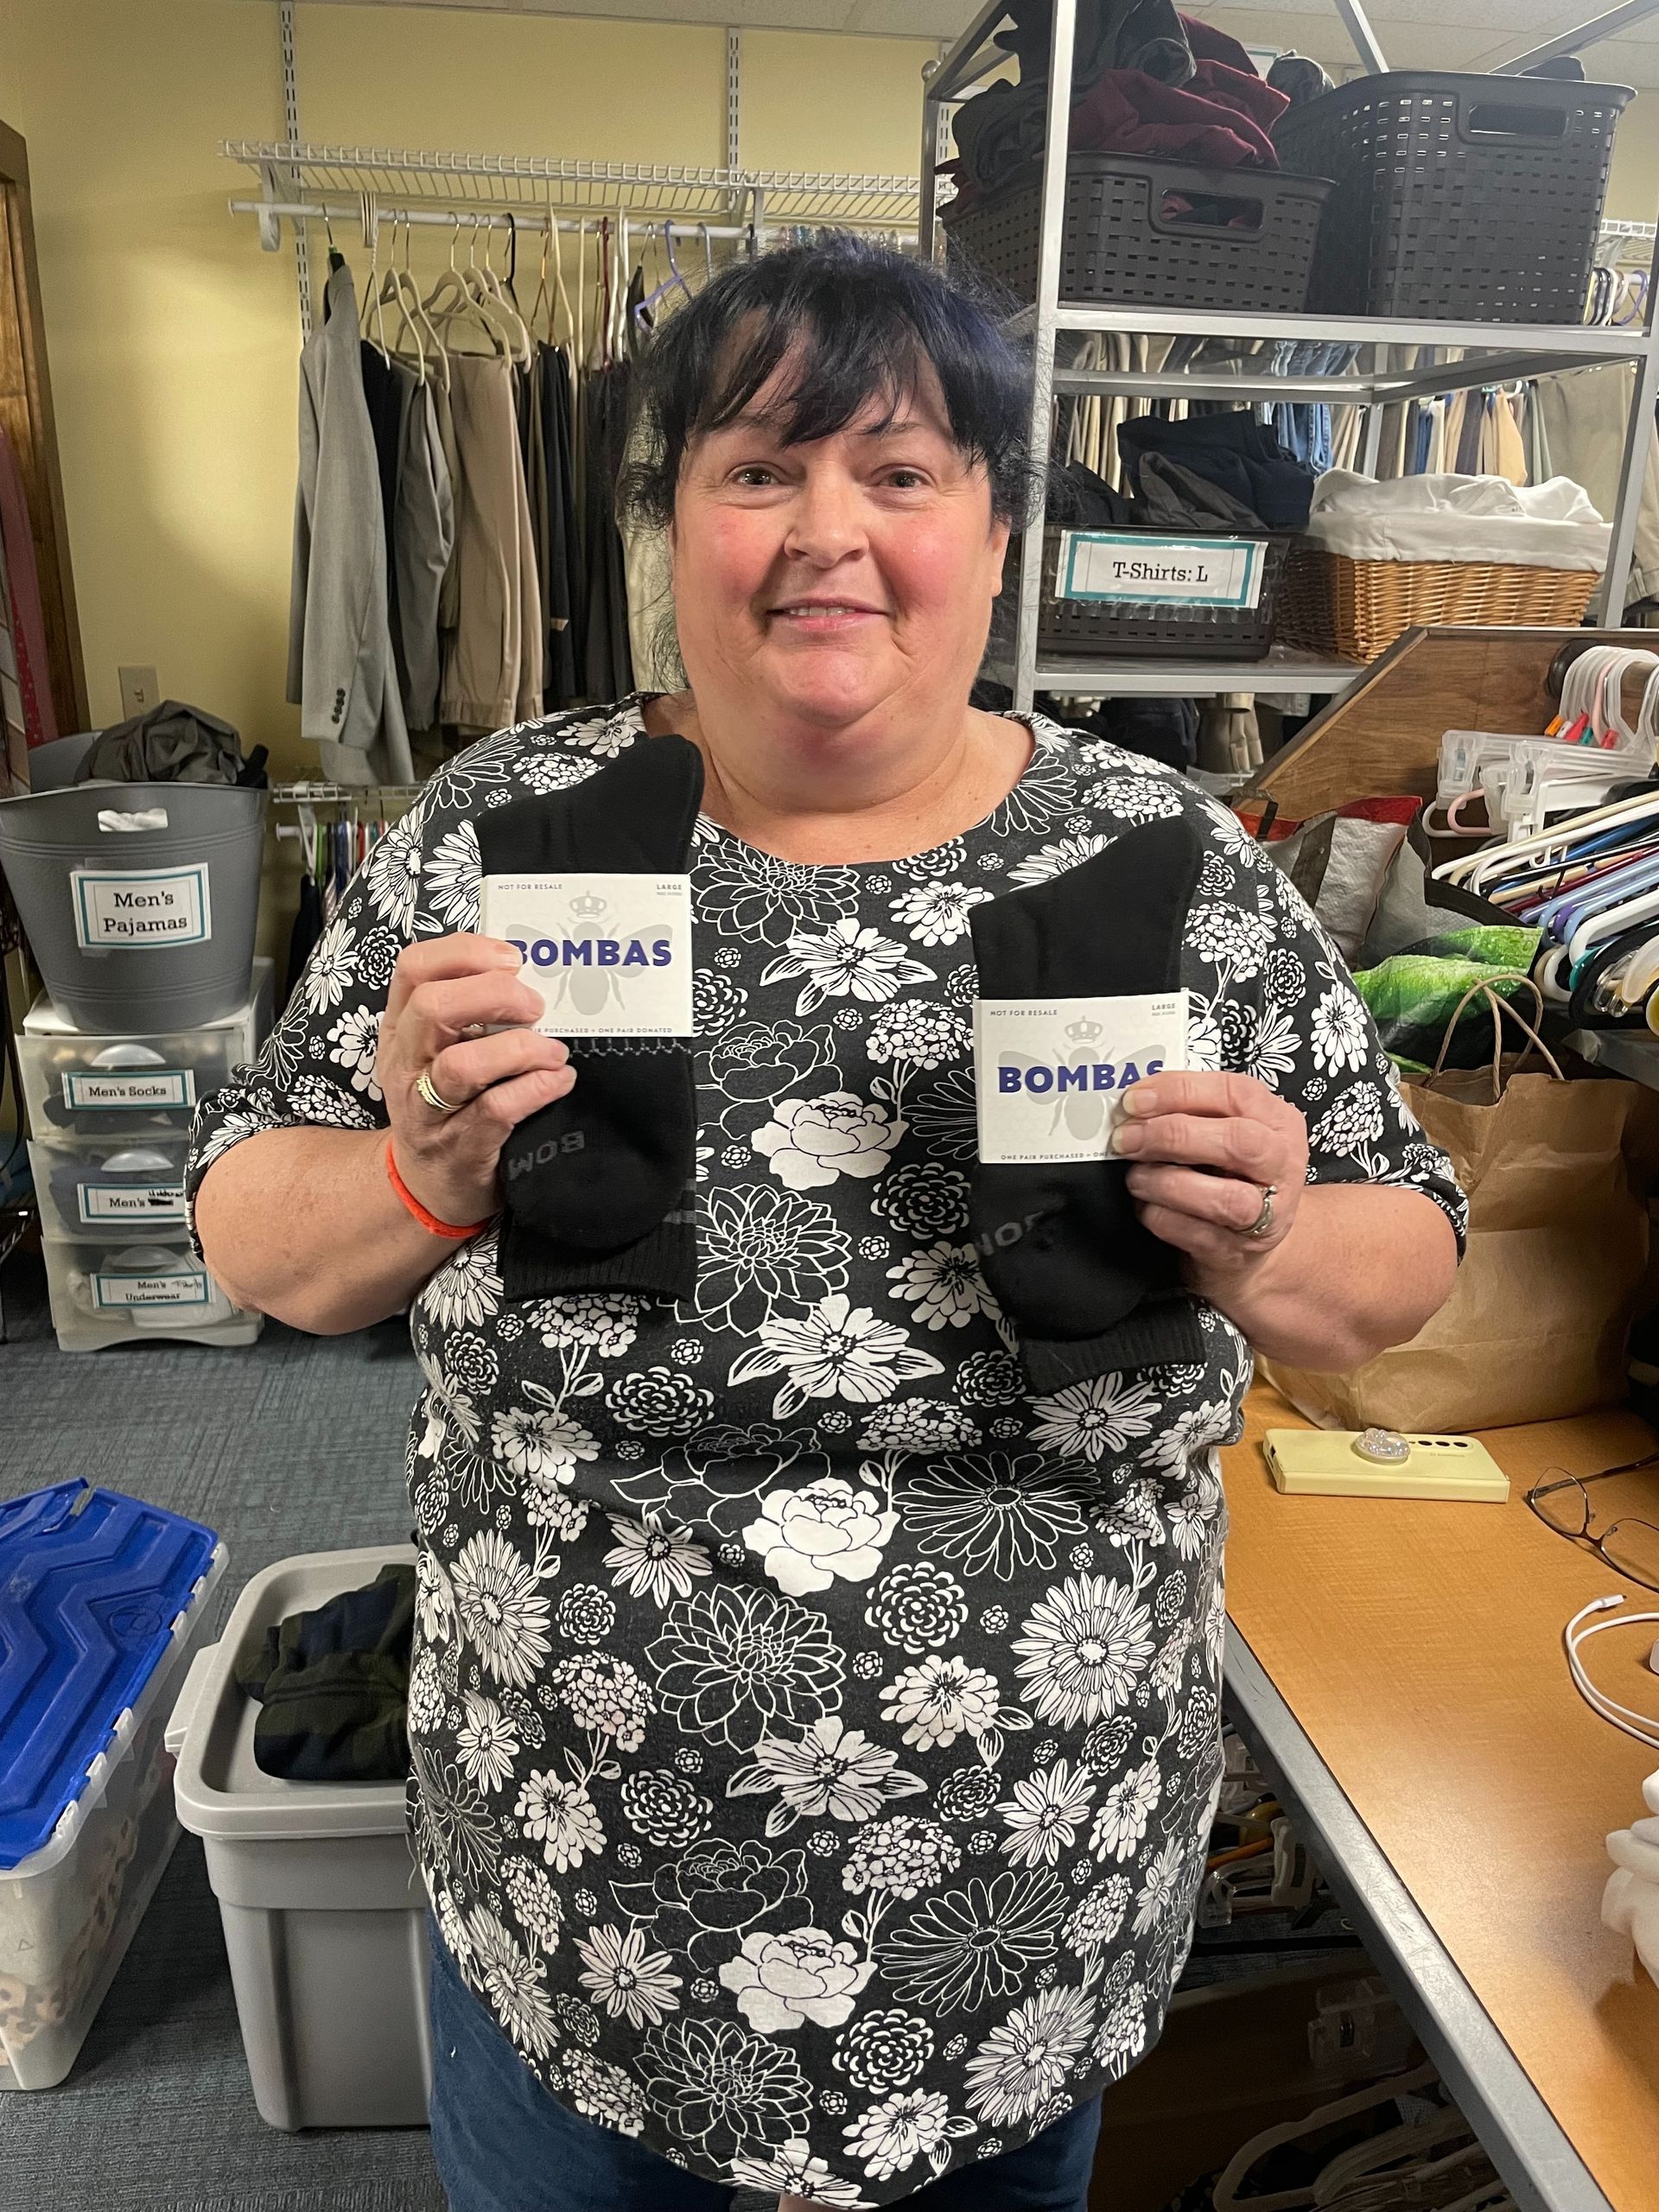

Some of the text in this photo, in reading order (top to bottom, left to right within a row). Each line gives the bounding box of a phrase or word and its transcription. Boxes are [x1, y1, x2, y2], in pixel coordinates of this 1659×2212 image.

[1113, 562, 1208, 582] T-Shirts: L
[113, 891, 174, 907] Men's
[103, 917, 188, 937] Pajamas
[1152, 1002, 1176, 1011] LARGE
[89, 1085, 167, 1096] Men's Socks
[109, 1197, 146, 1208] Men's
[137, 1281, 167, 1289] Men's
